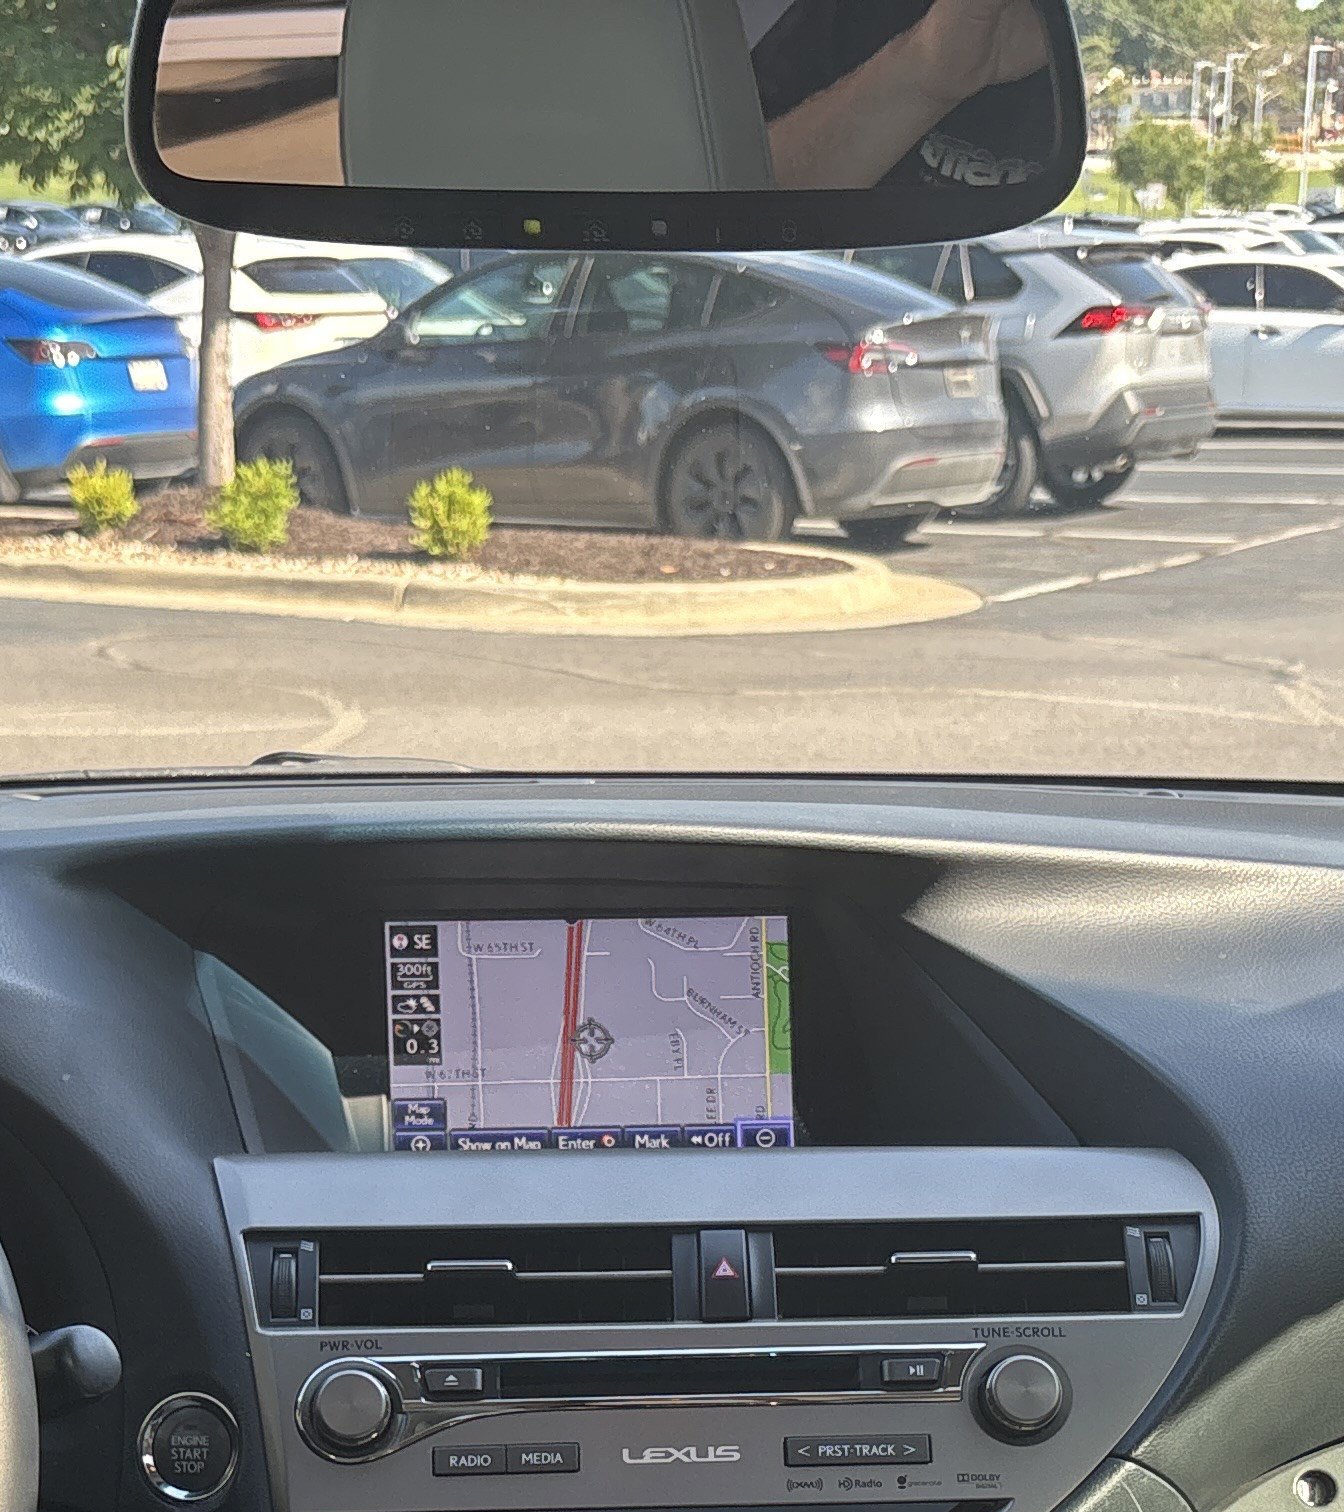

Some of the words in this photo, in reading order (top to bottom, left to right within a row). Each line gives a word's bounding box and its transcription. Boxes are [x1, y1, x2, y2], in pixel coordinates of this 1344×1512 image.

[749, 926, 760, 943] RD
[414, 934, 432, 950] SE
[473, 943, 484, 953] W
[520, 941, 535, 952] ST
[397, 963, 433, 976] 300ft
[749, 946, 761, 999] ANTIOCH
[403, 981, 427, 989] GPS
[405, 1038, 439, 1054] 0.3
[706, 1087, 718, 1103] DR
[408, 1104, 431, 1115] Map
[404, 1115, 435, 1126] Mode
[457, 1137, 493, 1150] Show
[496, 1142, 511, 1150] on
[513, 1137, 542, 1150] Map
[558, 1135, 595, 1150] Enter
[635, 1134, 670, 1149] Mark
[704, 1132, 731, 1148] Off
[171, 1435, 209, 1447] ENGINE
[171, 1447, 209, 1460] START
[449, 1453, 492, 1467] RADIO
[521, 1452, 564, 1466] MEDIA
[621, 1444, 741, 1464] LEXUS
[174, 1461, 205, 1474] STOP
[854, 1478, 883, 1489] Radio
[970, 1473, 1001, 1483] DOLBY
